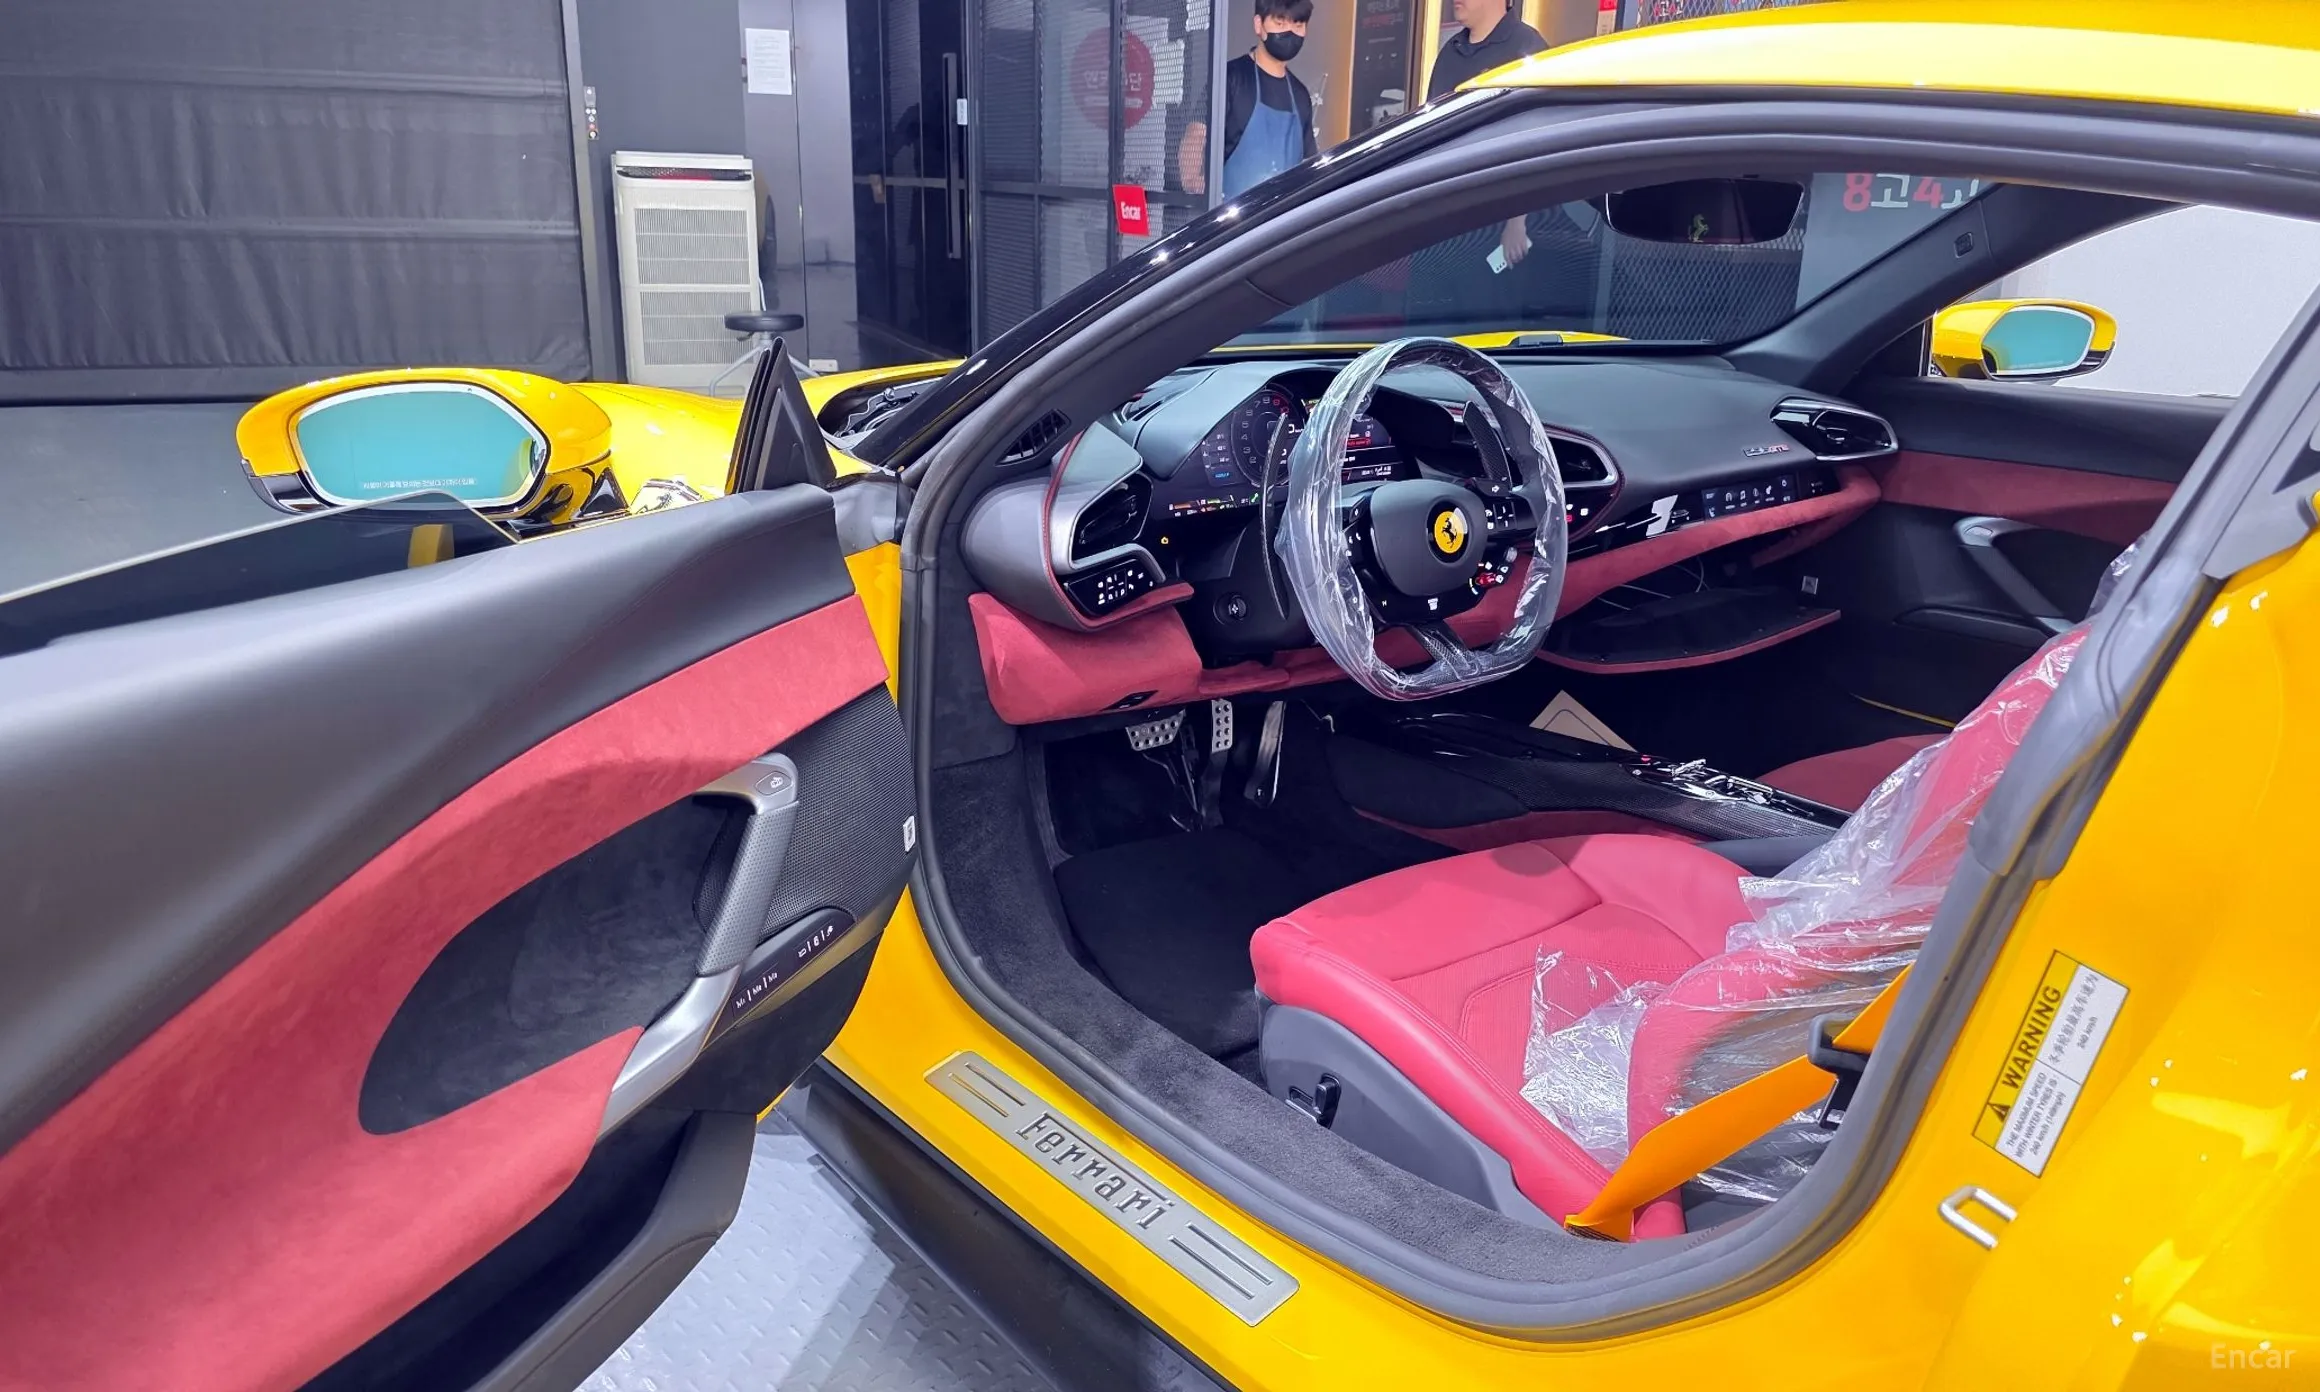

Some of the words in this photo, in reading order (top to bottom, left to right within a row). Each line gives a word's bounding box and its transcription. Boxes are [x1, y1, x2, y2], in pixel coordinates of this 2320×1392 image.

[1120, 200, 1141, 221] Encar
[2001, 984, 2061, 1089] WARNING
[2006, 1132, 2017, 1146] THE
[2015, 1139, 2028, 1157] WITH
[2023, 1111, 2041, 1139] WINTER
[1015, 1111, 1175, 1230] Ferrari
